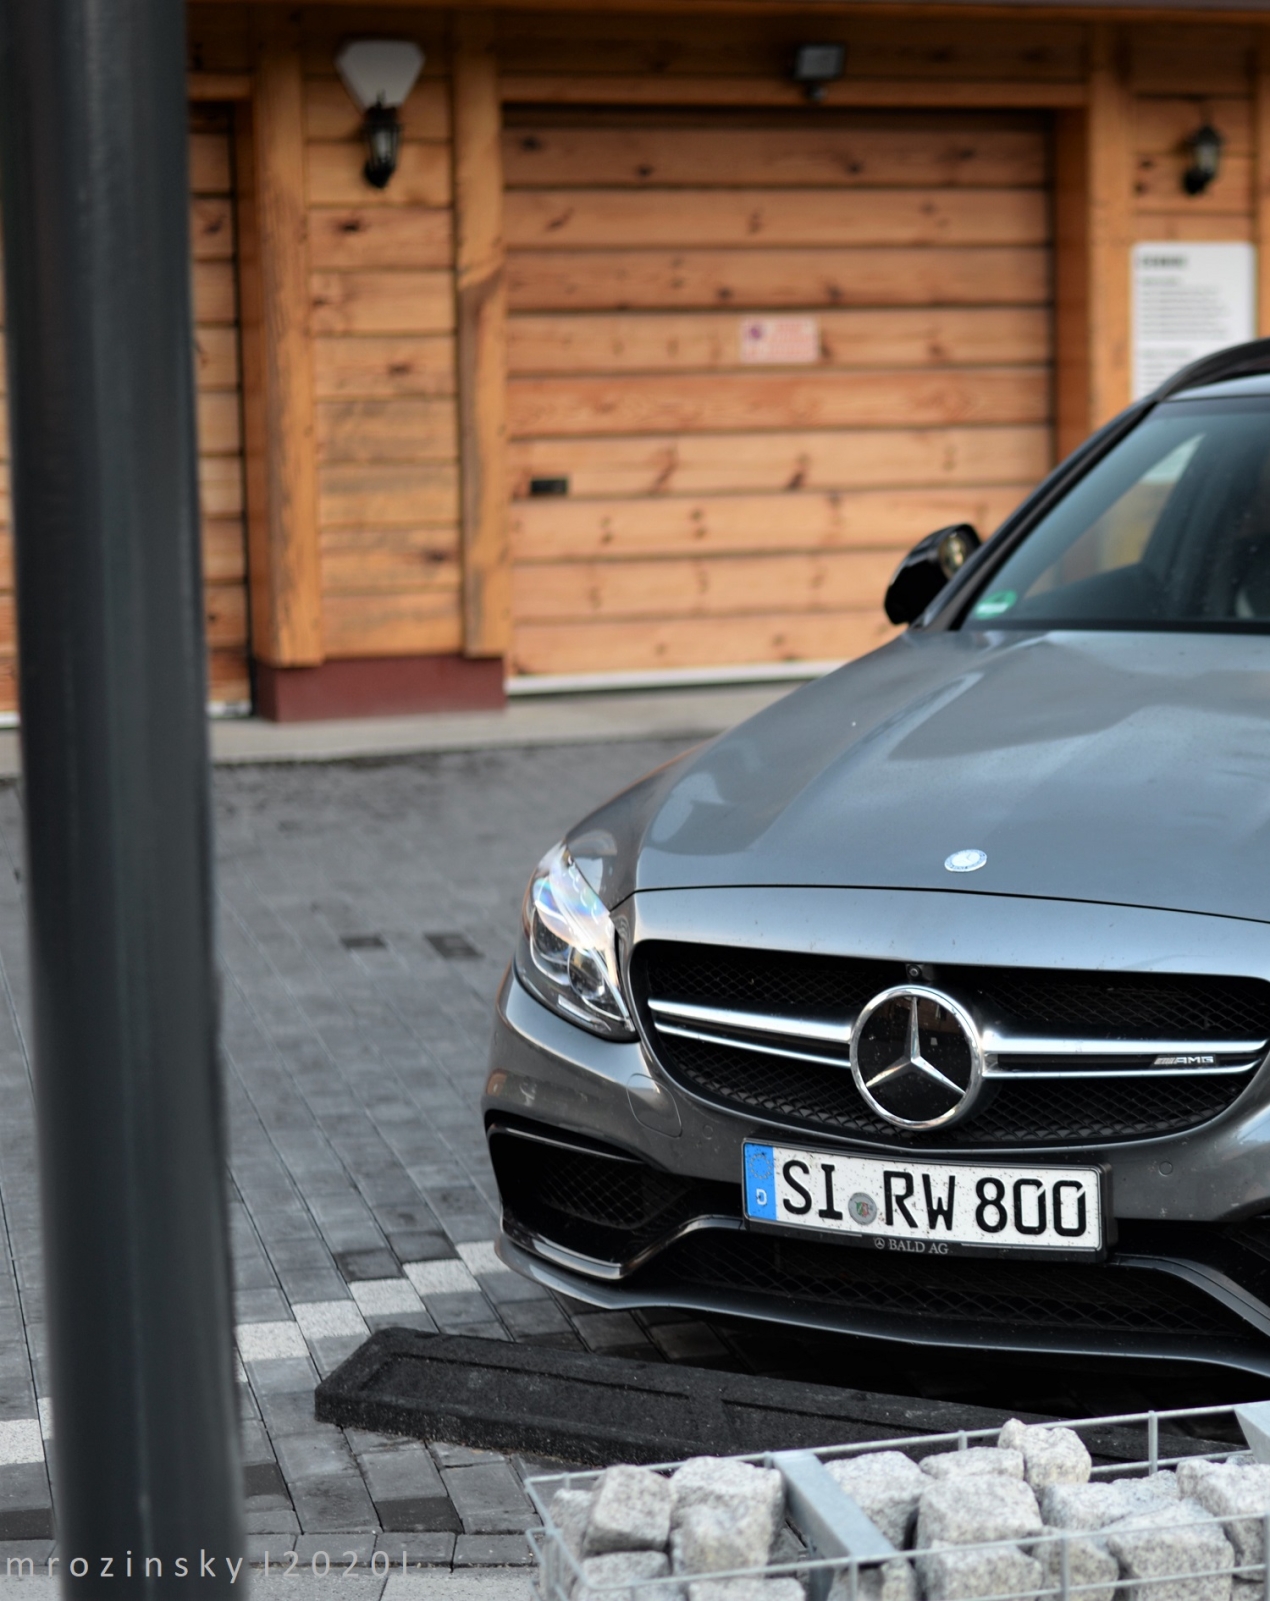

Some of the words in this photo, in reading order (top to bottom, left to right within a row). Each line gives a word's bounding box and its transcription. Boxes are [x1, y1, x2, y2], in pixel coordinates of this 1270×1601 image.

[1176, 1055, 1214, 1065] AMG
[756, 1188, 767, 1205] D
[782, 1159, 843, 1220] SI
[883, 1170, 956, 1231] RW
[975, 1177, 1087, 1237] 800
[889, 1239, 925, 1253] BALD
[928, 1242, 949, 1255] AG
